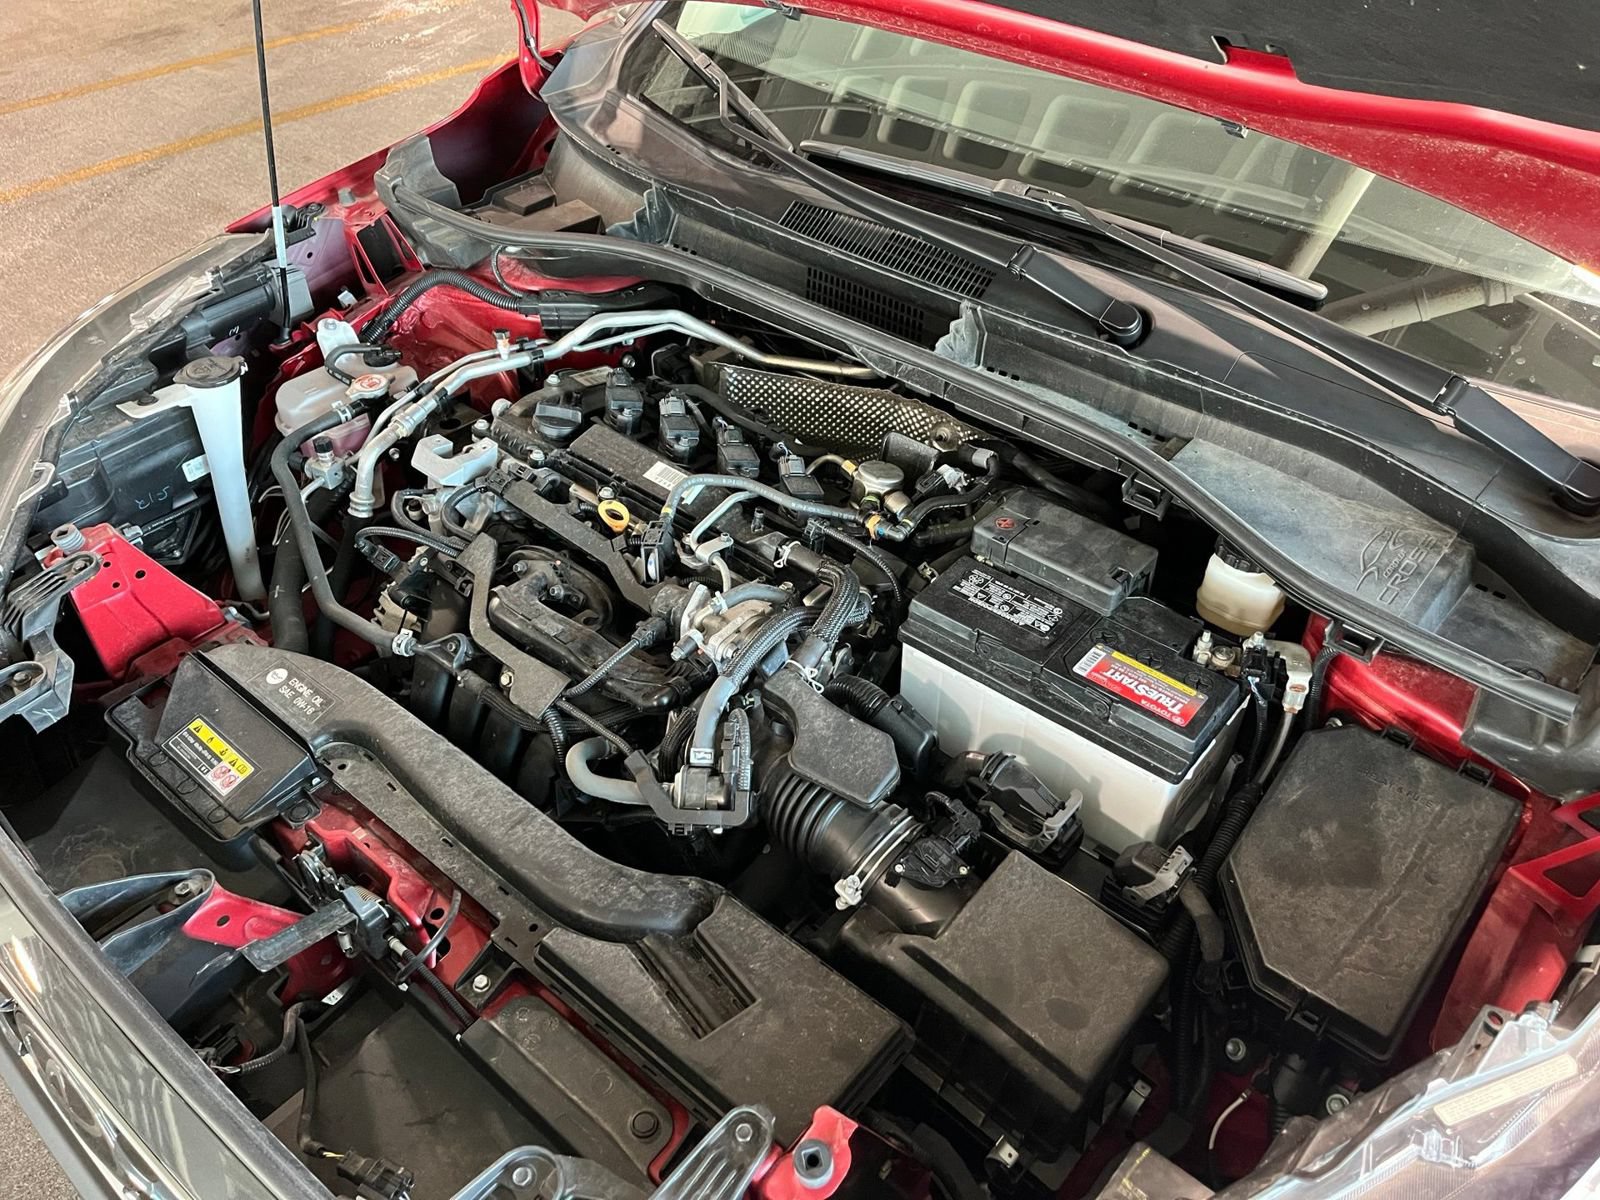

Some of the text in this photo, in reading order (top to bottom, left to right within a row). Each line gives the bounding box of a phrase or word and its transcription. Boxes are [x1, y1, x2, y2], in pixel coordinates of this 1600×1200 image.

[278, 685, 316, 715] SAE 0W-16
[288, 677, 325, 708] ENGINE OIL
[1139, 698, 1171, 718] TOYOTA
